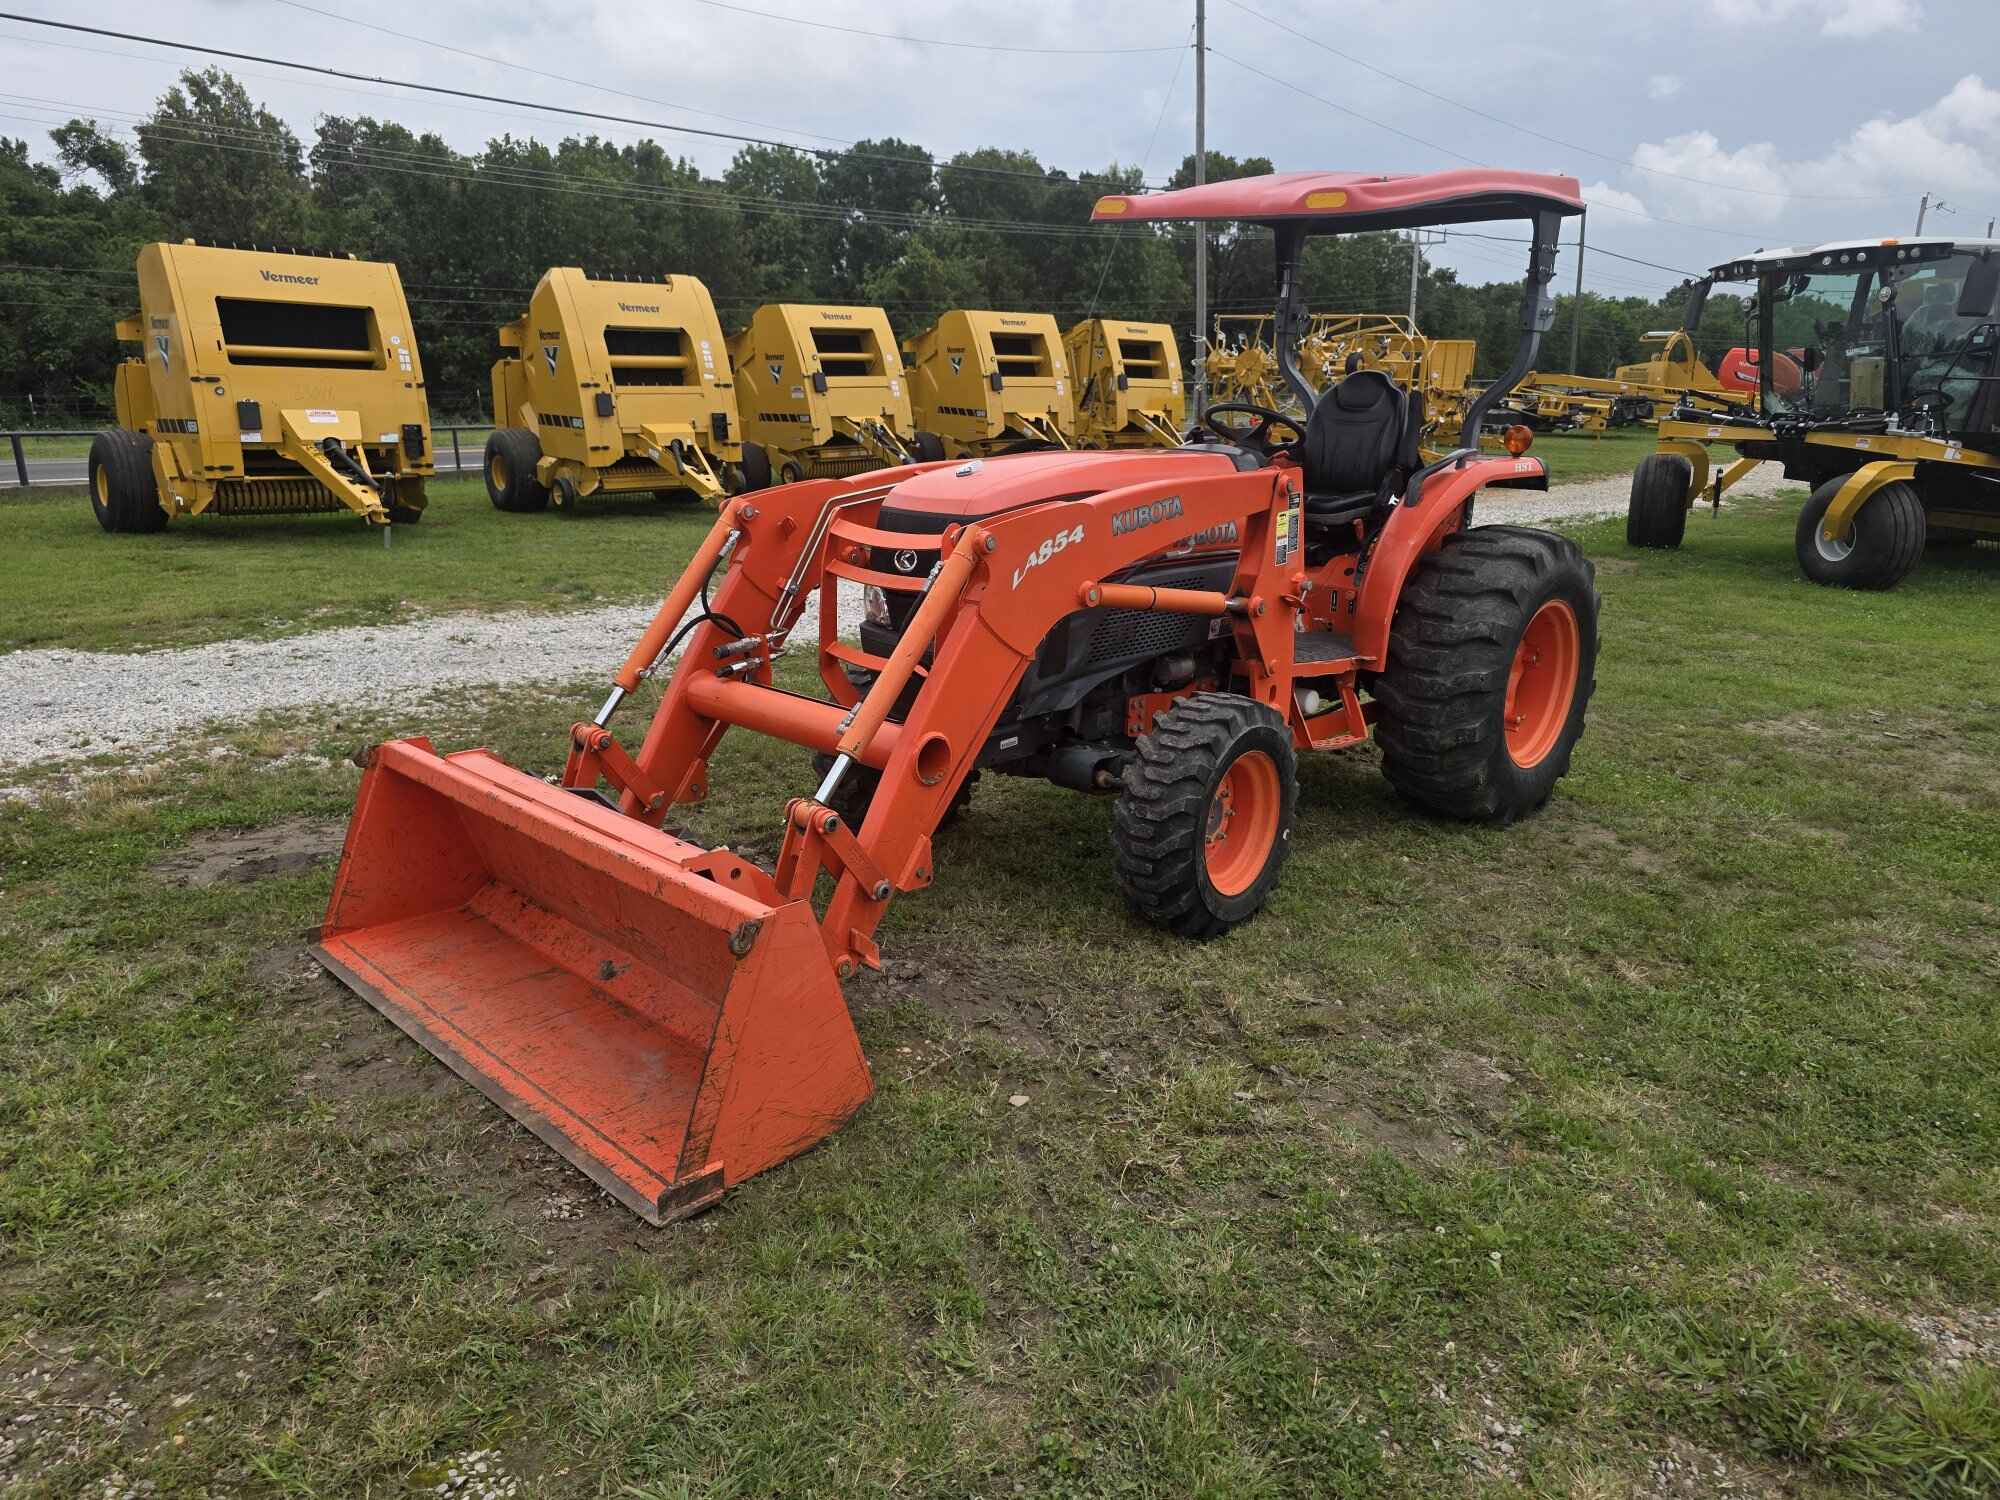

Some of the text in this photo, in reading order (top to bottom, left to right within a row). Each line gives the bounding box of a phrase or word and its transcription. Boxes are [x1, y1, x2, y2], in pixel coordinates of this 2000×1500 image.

[259, 270, 319, 286] Vermeer
[617, 302, 660, 313] Vermeer
[1112, 496, 1183, 536] KUBOTA
[1011, 524, 1085, 592] LA854
